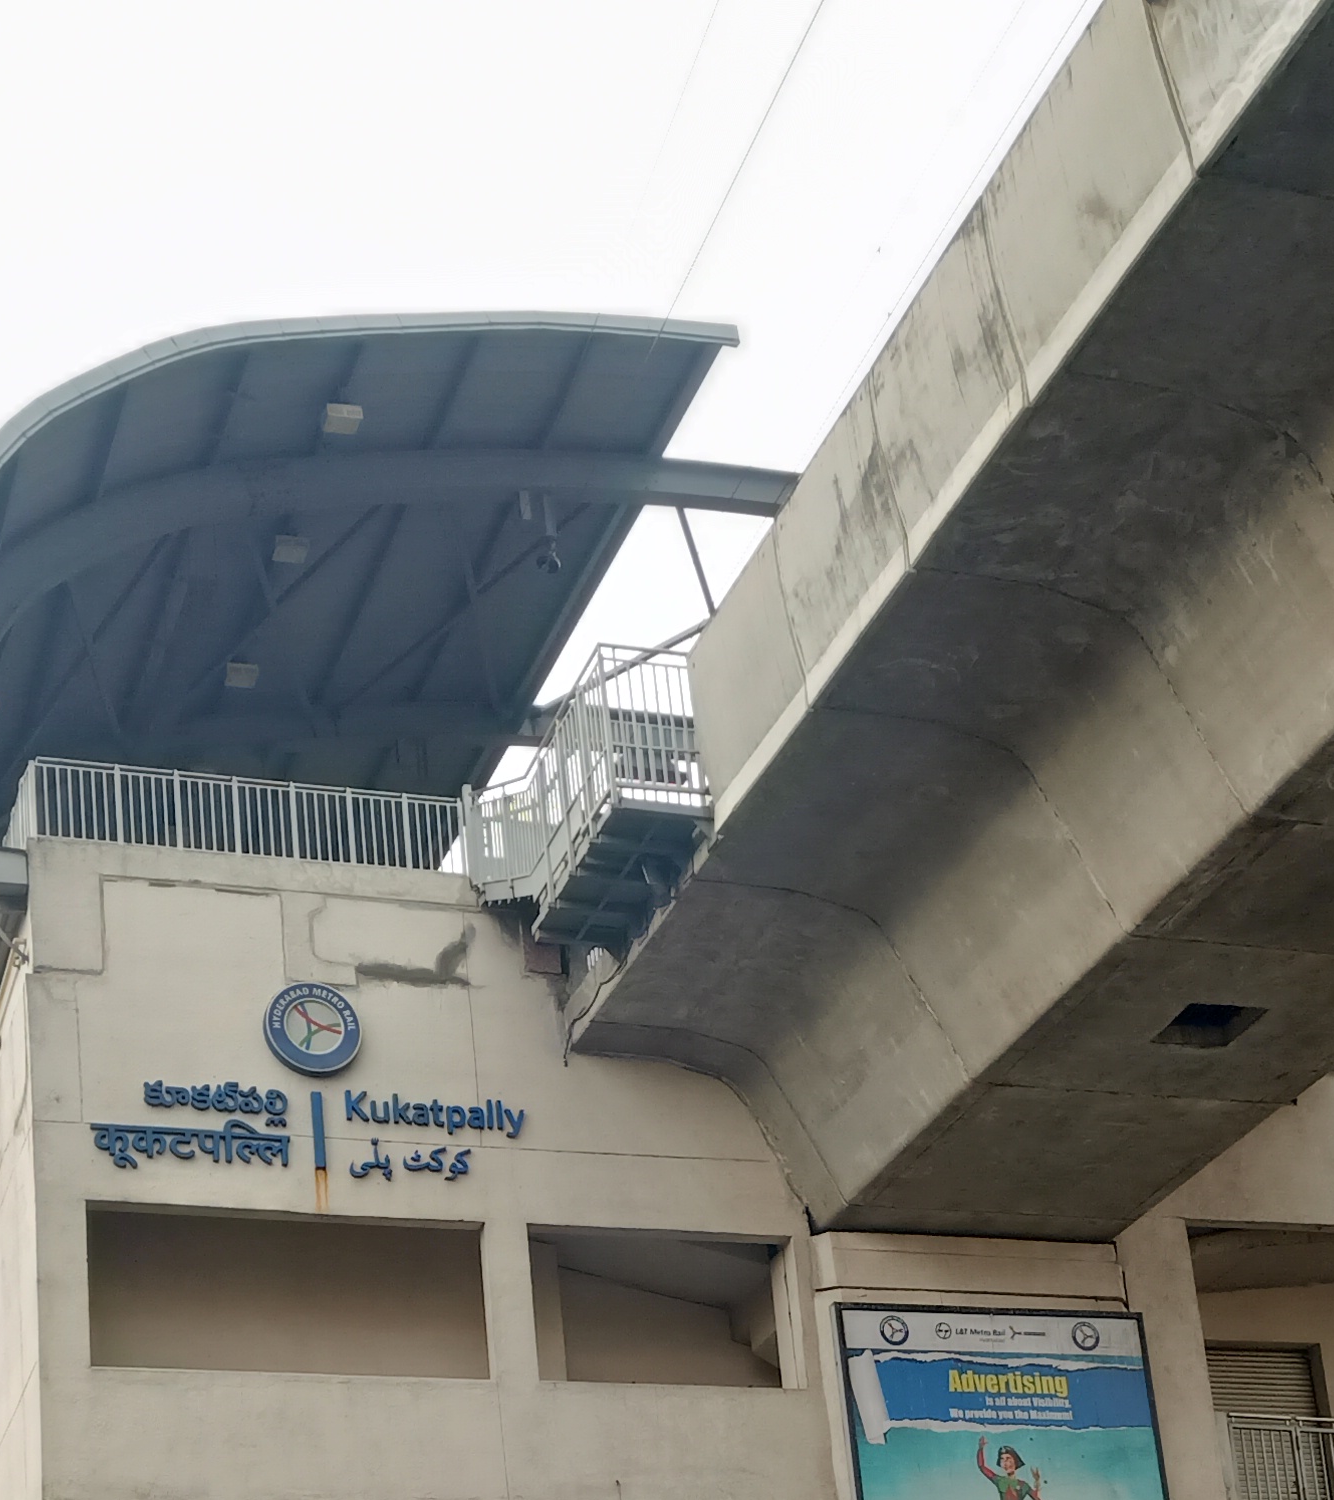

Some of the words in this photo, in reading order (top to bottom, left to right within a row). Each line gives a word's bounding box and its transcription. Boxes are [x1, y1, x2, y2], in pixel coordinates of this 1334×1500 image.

[272, 987, 309, 1029] HYDERABAD
[312, 987, 345, 1009] METRO
[342, 1009, 356, 1031] RAIL
[344, 1089, 525, 1138] Kukatpally
[970, 1328, 991, 1336] Metro
[949, 1369, 1068, 1398] Advertising
[995, 1396, 1006, 1406] all
[949, 1408, 964, 1418] We
[965, 1409, 997, 1420] provide
[998, 1410, 1012, 1420] you
[1013, 1410, 1029, 1419] the
